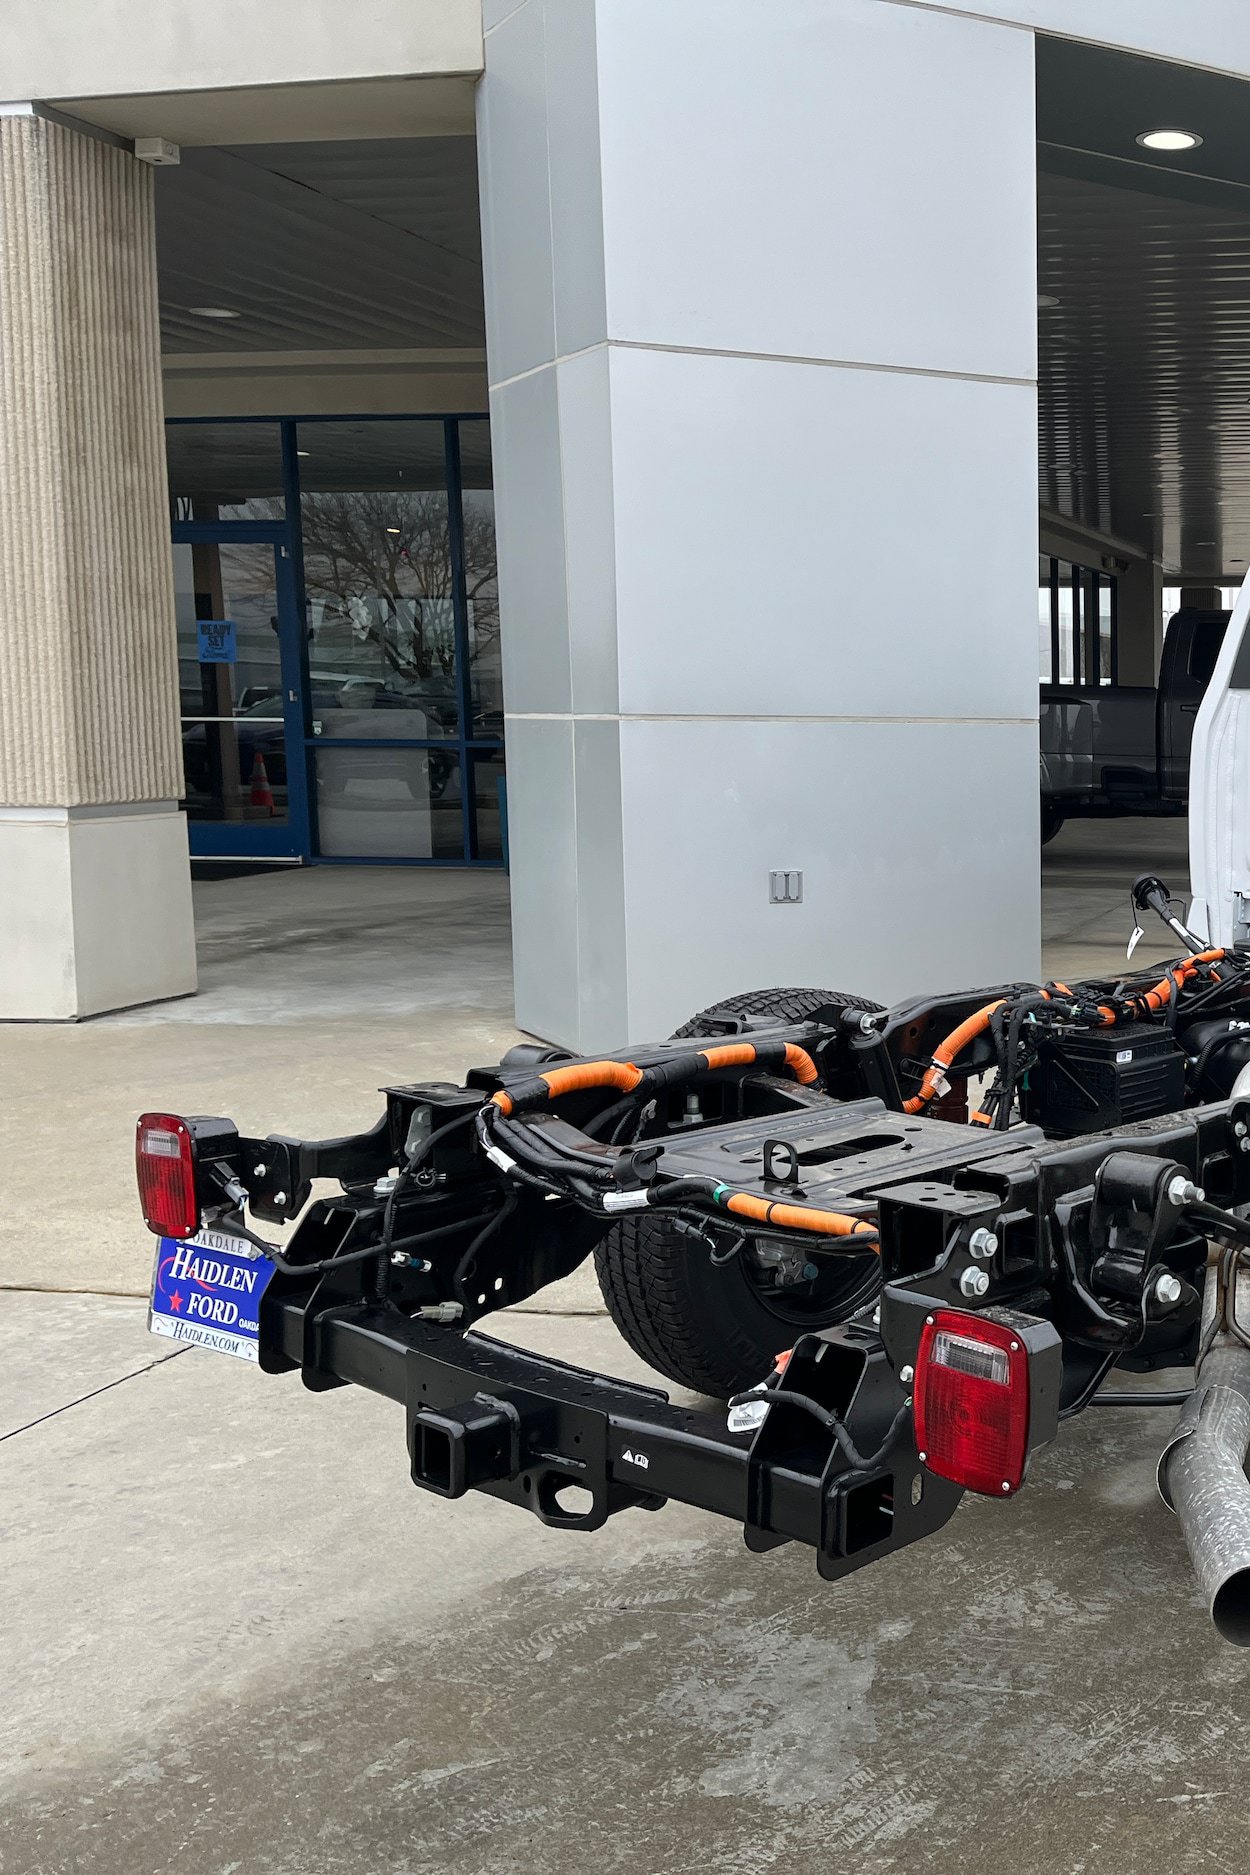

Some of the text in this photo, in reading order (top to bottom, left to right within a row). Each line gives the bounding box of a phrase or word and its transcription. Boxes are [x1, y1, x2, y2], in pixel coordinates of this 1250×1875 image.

[194, 1234, 243, 1253] OAKDALE
[169, 1247, 259, 1293] HAIDLEN
[186, 1293, 238, 1325] FORD
[173, 1321, 239, 1353] HAIDLEN.COM
